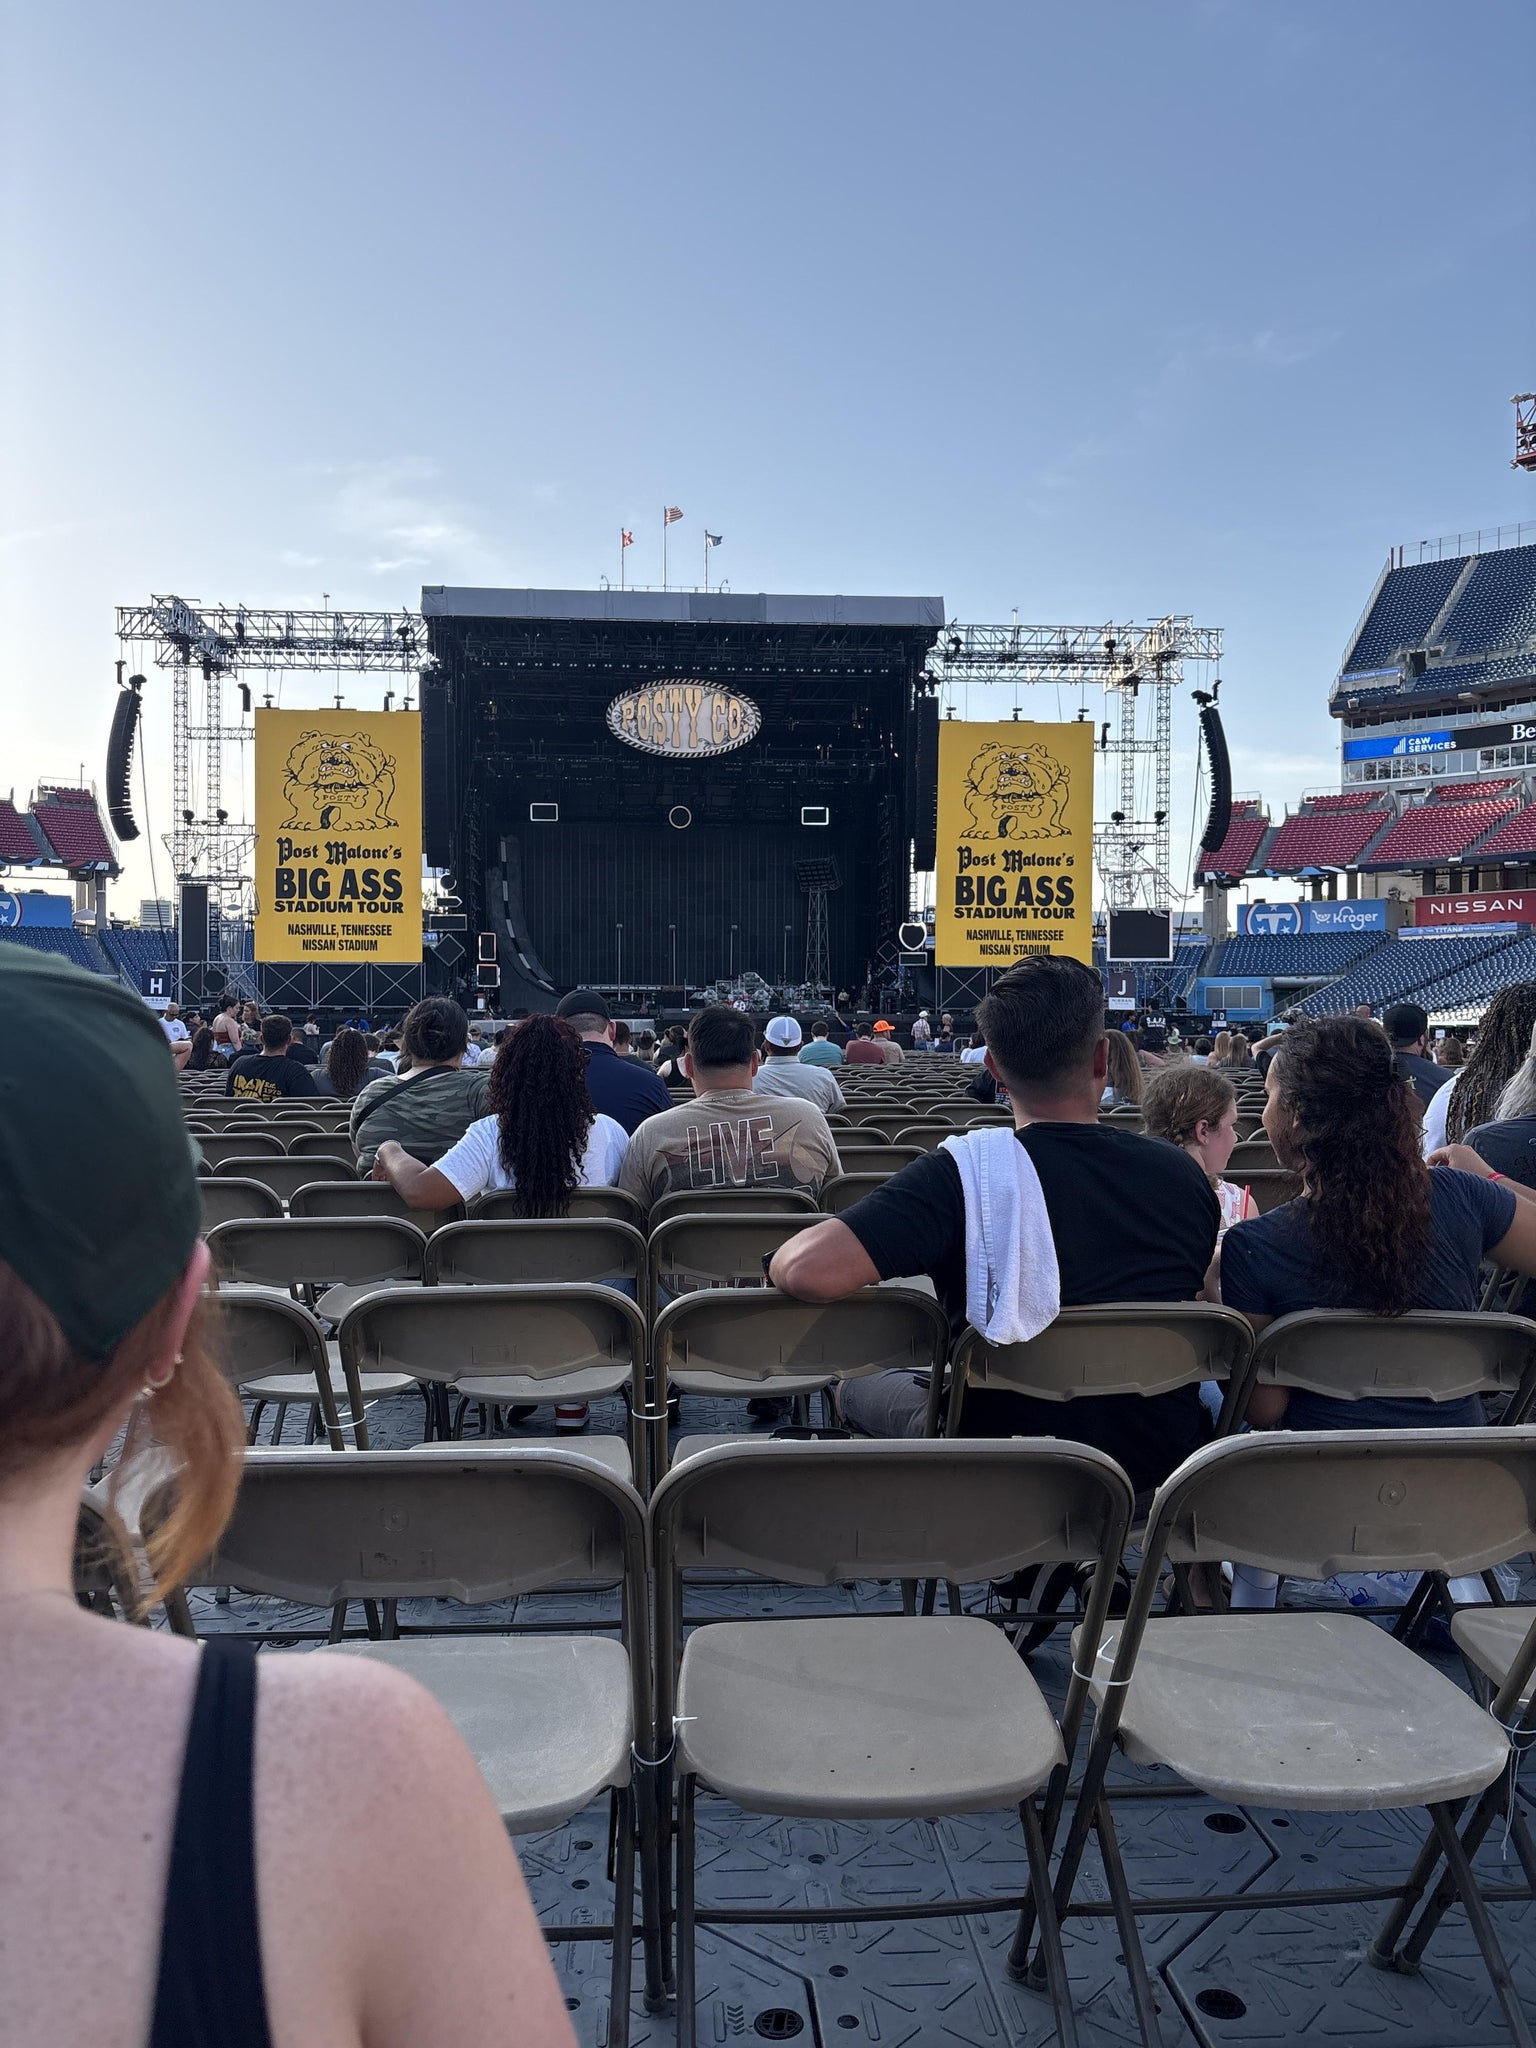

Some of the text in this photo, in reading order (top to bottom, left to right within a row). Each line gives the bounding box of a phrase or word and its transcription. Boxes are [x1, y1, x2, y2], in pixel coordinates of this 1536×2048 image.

[621, 688, 702, 748] POSTY
[1511, 724, 1536, 740] Be
[1408, 737, 1431, 746] C&W
[1408, 741, 1456, 753] SERVICES
[322, 794, 360, 802] POSTY
[1000, 804, 1036, 812] POSTY
[276, 837, 402, 866] Post Malone's
[956, 846, 1074, 874] Post Malone's
[275, 868, 403, 901] BIG ASS
[955, 875, 1075, 907] BIG ASS
[274, 901, 404, 914] STADIUM TOUR
[954, 907, 1075, 919] STADIUM TOUR
[1430, 898, 1523, 915] NISSAN
[1333, 906, 1378, 930] Kroger
[288, 923, 392, 938] NASHVILLE, TENNESSEE
[966, 929, 1064, 943] NASHVILLE, TENNESSEE
[302, 939, 378, 951] NISSAN STADIUM
[979, 944, 1050, 956] NISSAN STADIUM
[150, 978, 163, 994] H
[1117, 980, 1126, 995] J
[687, 1115, 779, 1188] LIVE
